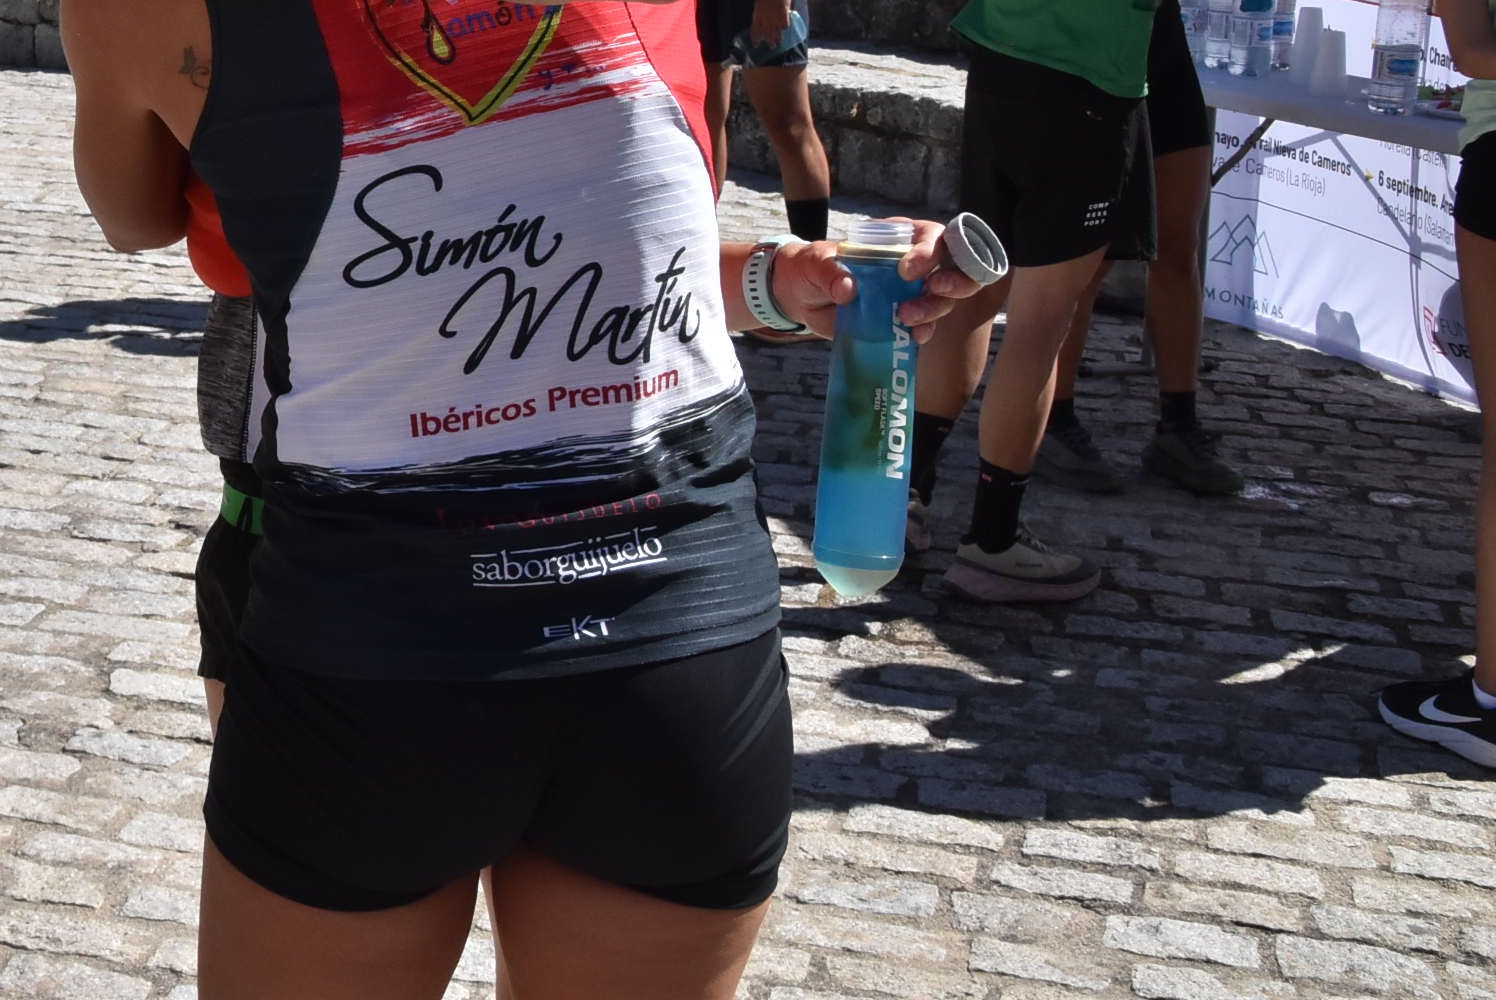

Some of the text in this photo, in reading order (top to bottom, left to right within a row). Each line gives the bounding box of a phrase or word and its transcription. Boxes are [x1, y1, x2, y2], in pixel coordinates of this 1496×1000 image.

[1245, 158, 1285, 184] Cameros
[1302, 171, 1326, 197] Rioja)
[1273, 140, 1297, 161] Nieva
[1299, 149, 1309, 164] de
[1311, 149, 1352, 176] Cameros
[1378, 170, 1384, 187] 6
[1385, 175, 1438, 209] septiembre.
[343, 164, 563, 289] Simón
[438, 246, 700, 376] Martín
[1204, 287, 1284, 319] MONTAÑAS
[409, 368, 680, 438] Ibéricos Premium
[472, 527, 663, 585] saborguijuelo
